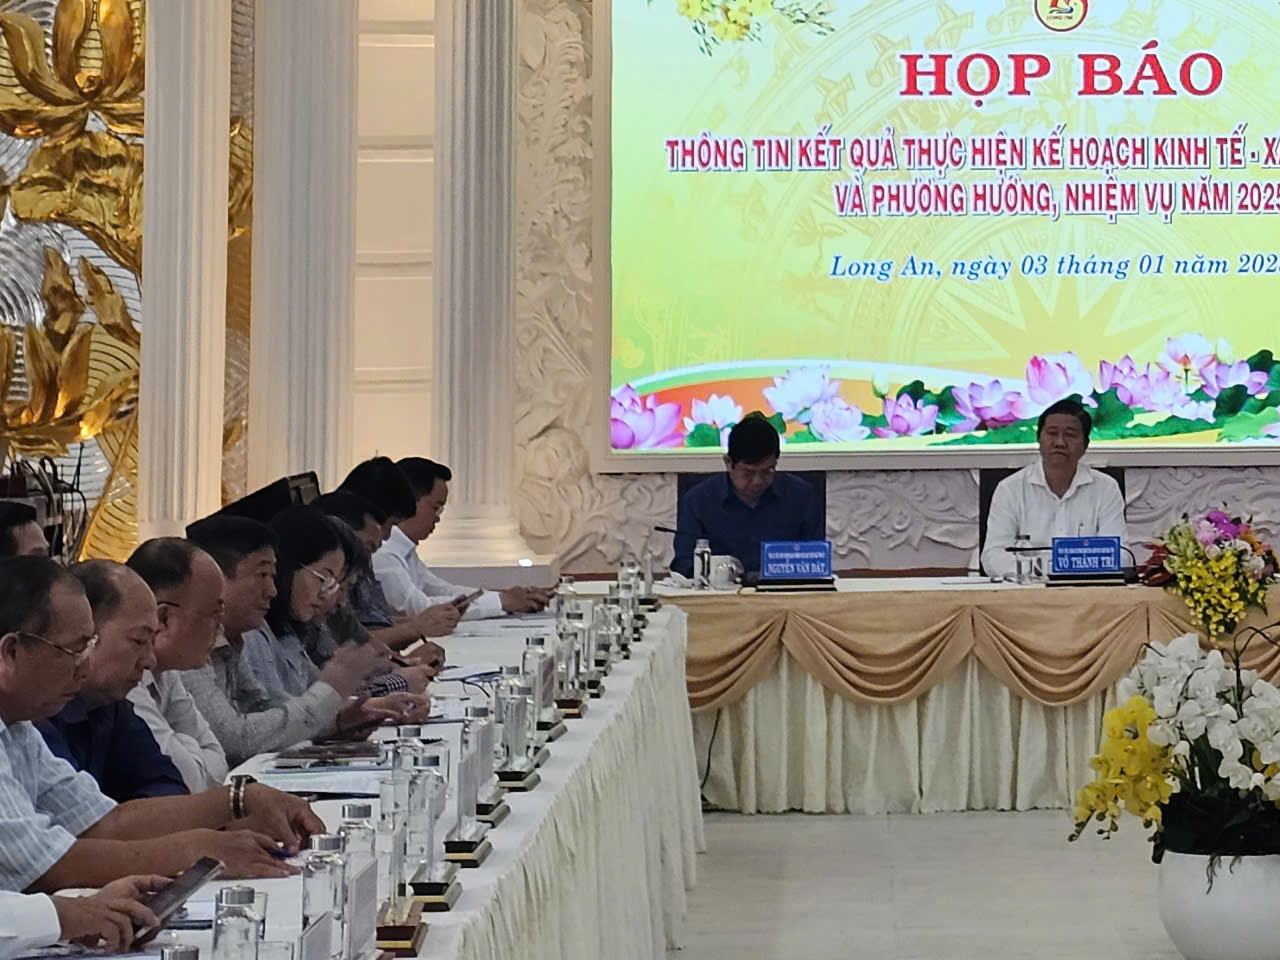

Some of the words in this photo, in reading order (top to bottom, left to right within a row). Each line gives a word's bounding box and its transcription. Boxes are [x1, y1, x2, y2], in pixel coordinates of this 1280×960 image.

[899, 52, 1051, 107] HỌP
[1077, 39, 1223, 96] BÁO
[665, 131, 746, 170] THÔNG
[752, 138, 790, 169] TIN
[798, 124, 843, 169] KẾT
[850, 126, 896, 169] QUẢ
[903, 131, 963, 176] THỰC
[971, 130, 1024, 176] HIỆN
[1032, 124, 1066, 167] KẾ
[1069, 137, 1146, 175] HOẠCH
[1154, 137, 1208, 167] KINH
[1215, 123, 1247, 167] TẾ
[834, 176, 864, 213] VÀ
[872, 178, 965, 213] PHƯƠNG
[972, 174, 1058, 218] HƯỚNG,
[1065, 175, 1137, 222] NHIỆM
[1144, 182, 1174, 222] VỤ
[1180, 175, 1229, 212] NĂM
[828, 255, 893, 281] Long
[901, 255, 942, 278] An,
[951, 254, 1011, 281] ngày
[1020, 254, 1048, 275] 03
[1056, 253, 1130, 280] tháng
[1138, 253, 1165, 275] 01
[1173, 253, 1228, 274] năm
